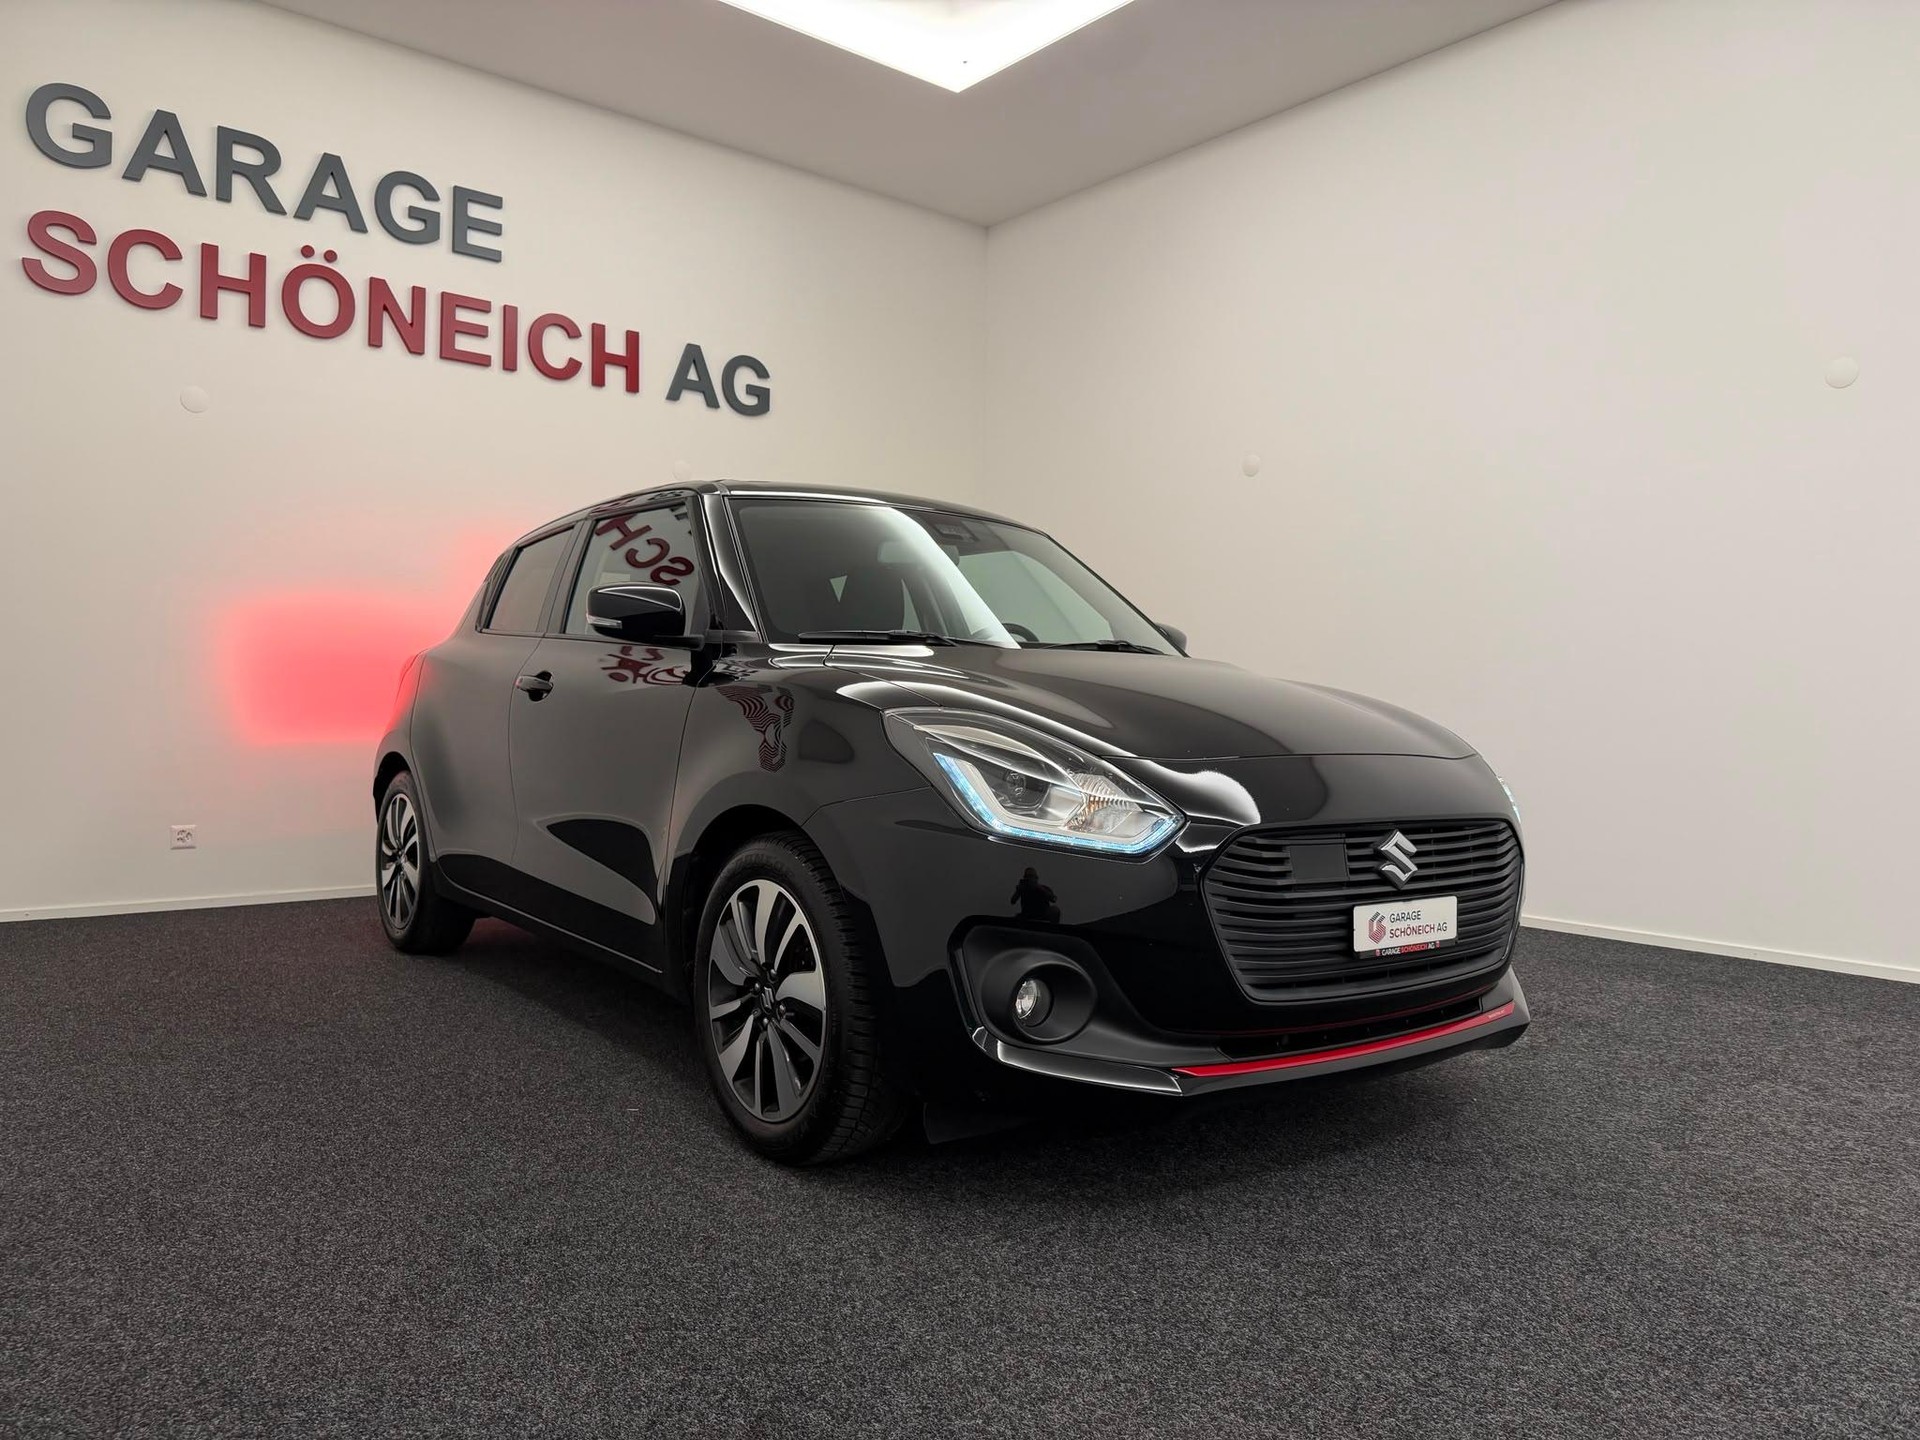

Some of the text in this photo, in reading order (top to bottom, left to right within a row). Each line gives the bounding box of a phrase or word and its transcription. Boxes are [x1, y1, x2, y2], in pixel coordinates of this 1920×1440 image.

[25, 82, 503, 263] GARAGE
[21, 210, 771, 417] SCHÖNEICH AG
[1390, 911, 1421, 923] GARAGE
[1390, 922, 1447, 938] SCHÖNEICH AG
[1382, 947, 1401, 955] GARAGE
